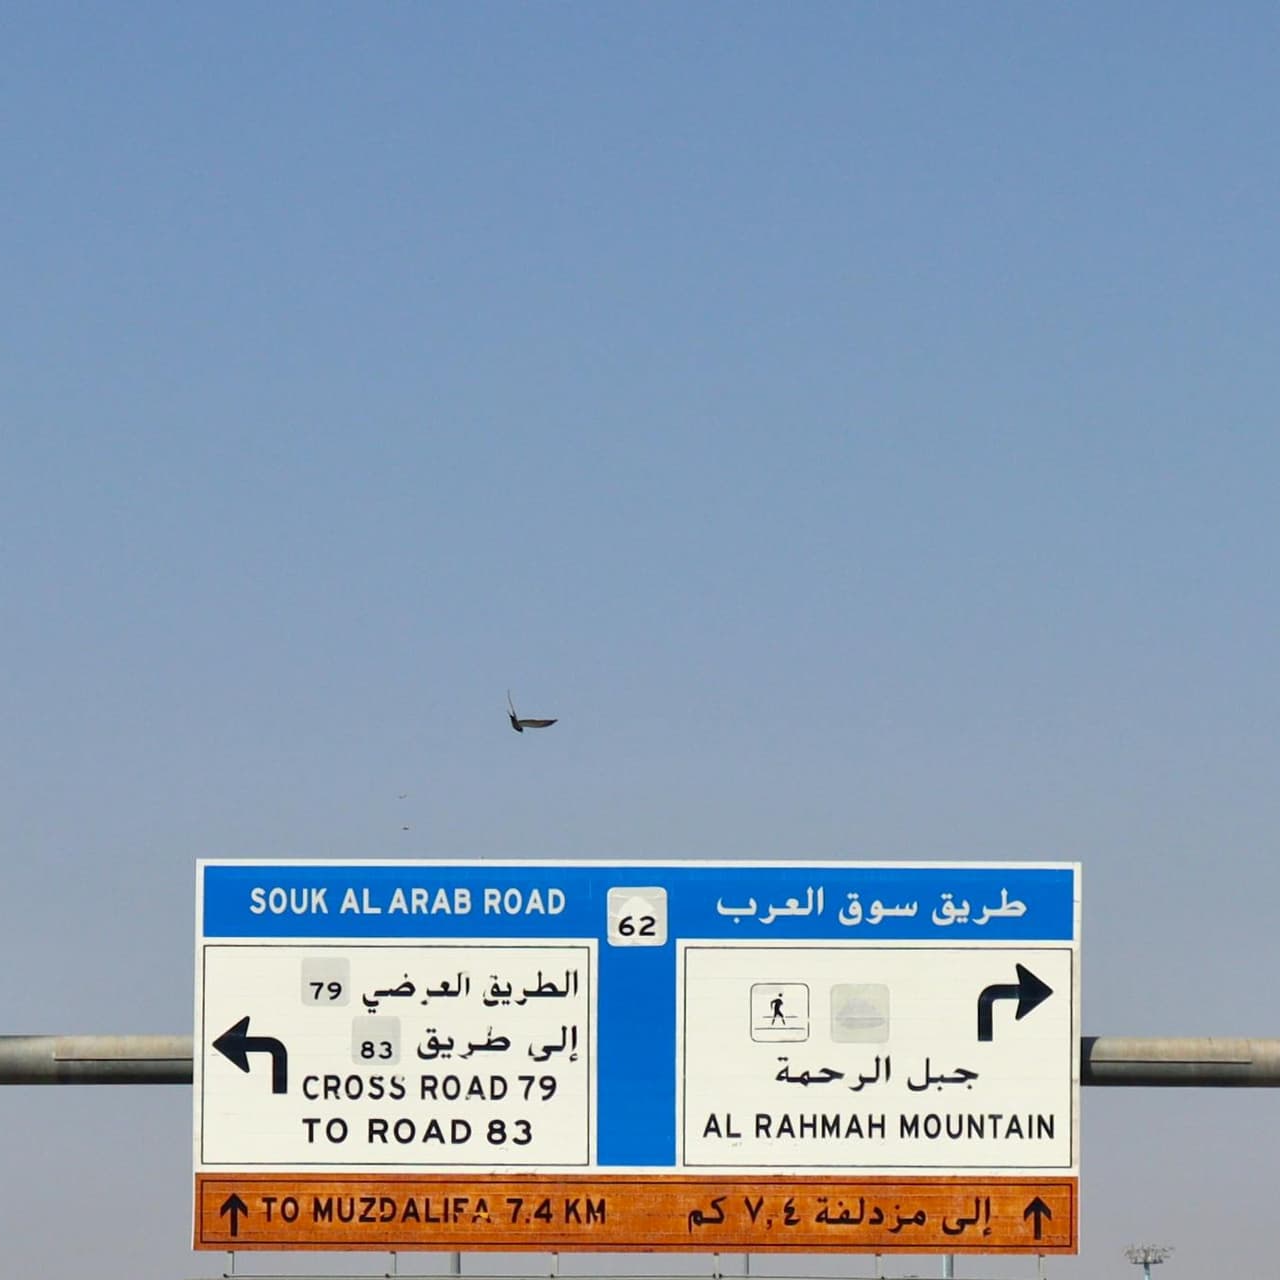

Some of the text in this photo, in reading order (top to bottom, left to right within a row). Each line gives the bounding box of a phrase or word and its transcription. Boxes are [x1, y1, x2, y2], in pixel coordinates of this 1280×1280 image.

[250, 887, 566, 915] SOUK AL ARAB ROAD
[716, 886, 1027, 926] طريق سوق العرب
[618, 915, 657, 937] 62
[309, 981, 343, 1001] 79
[483, 970, 578, 1007] الطريق
[360, 1025, 578, 1062] إلى طريق 83
[302, 1074, 558, 1101] CROSS ROAD 79
[775, 1055, 980, 1093] جبل الرحمة
[302, 1117, 533, 1146] TO ROAD 83
[703, 1113, 1055, 1140] AL RAHMAH MOUNTAIN
[262, 1197, 606, 1224] TO MUZDALIFA 7.4 KM
[688, 1196, 728, 1233] كم
[815, 1197, 926, 1234] مزدلفة
[942, 1196, 992, 1236] إلى
